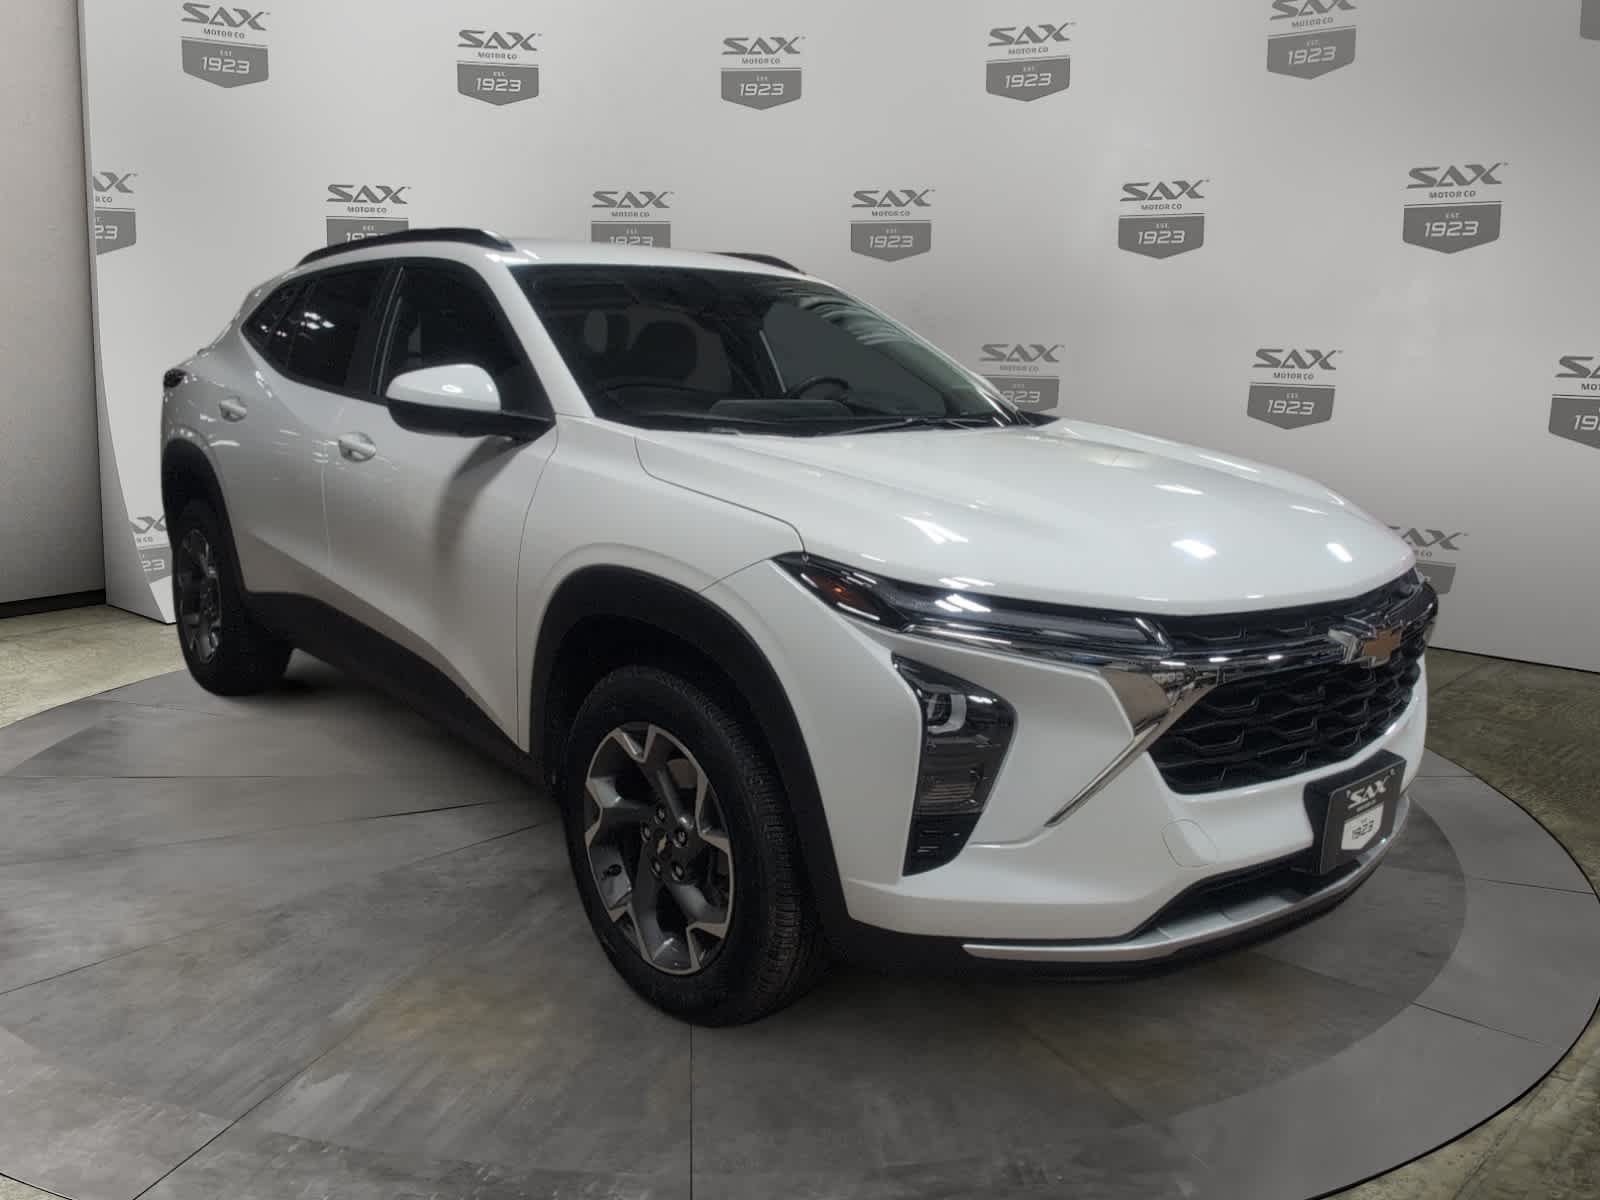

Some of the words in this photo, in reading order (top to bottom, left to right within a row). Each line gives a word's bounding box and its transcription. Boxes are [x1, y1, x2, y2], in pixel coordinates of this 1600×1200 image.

[181, 3, 267, 31] SAX
[203, 28, 233, 38] MOTOR
[457, 30, 538, 51] SAX
[987, 22, 1070, 47] SAX
[722, 36, 801, 55] SAX
[1288, 46, 1336, 65] 1923
[202, 56, 250, 74] 1923
[476, 77, 522, 92] 1923
[1005, 73, 1052, 88] 1923
[740, 83, 784, 96] 1923
[1406, 163, 1503, 189] SAX
[326, 184, 408, 204] SAX
[591, 191, 670, 208] SAX
[851, 189, 931, 208] SAX
[1119, 180, 1205, 202] SAX
[1428, 191, 1463, 199] MOTOR
[95, 225, 118, 240] 23
[1424, 220, 1479, 237] 1923
[609, 236, 654, 248] 1923
[869, 235, 913, 248] 1923
[1137, 230, 1185, 245] 1923
[979, 344, 1060, 363] SAX
[1252, 349, 1336, 370] SAX
[1001, 390, 1041, 404] 923
[1267, 399, 1315, 415] 1923
[1574, 415, 1600, 431] 19
[141, 559, 165, 572] 23
[1346, 775, 1390, 810] SAX
